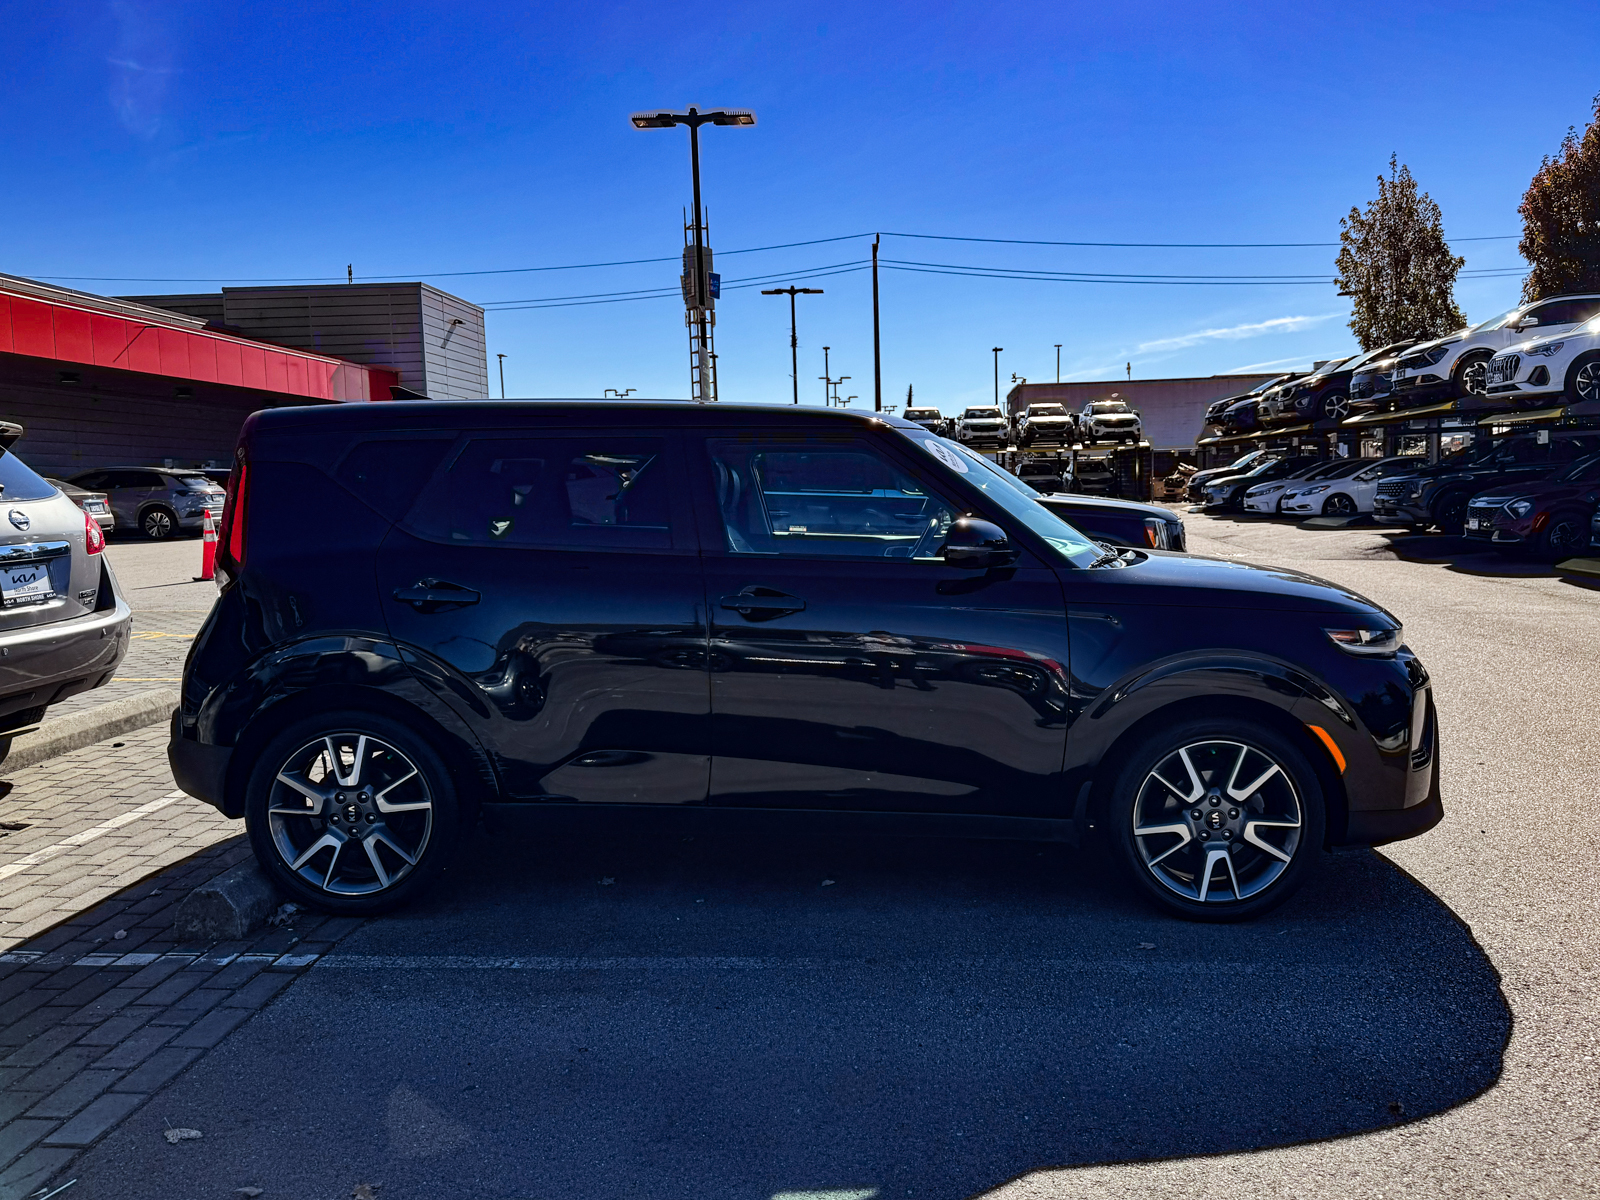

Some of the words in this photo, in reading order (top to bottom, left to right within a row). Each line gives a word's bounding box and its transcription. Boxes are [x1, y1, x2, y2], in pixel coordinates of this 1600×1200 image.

[11, 572, 37, 584] KIA
[348, 805, 356, 822] KIA
[1211, 812, 1220, 829] KIA
